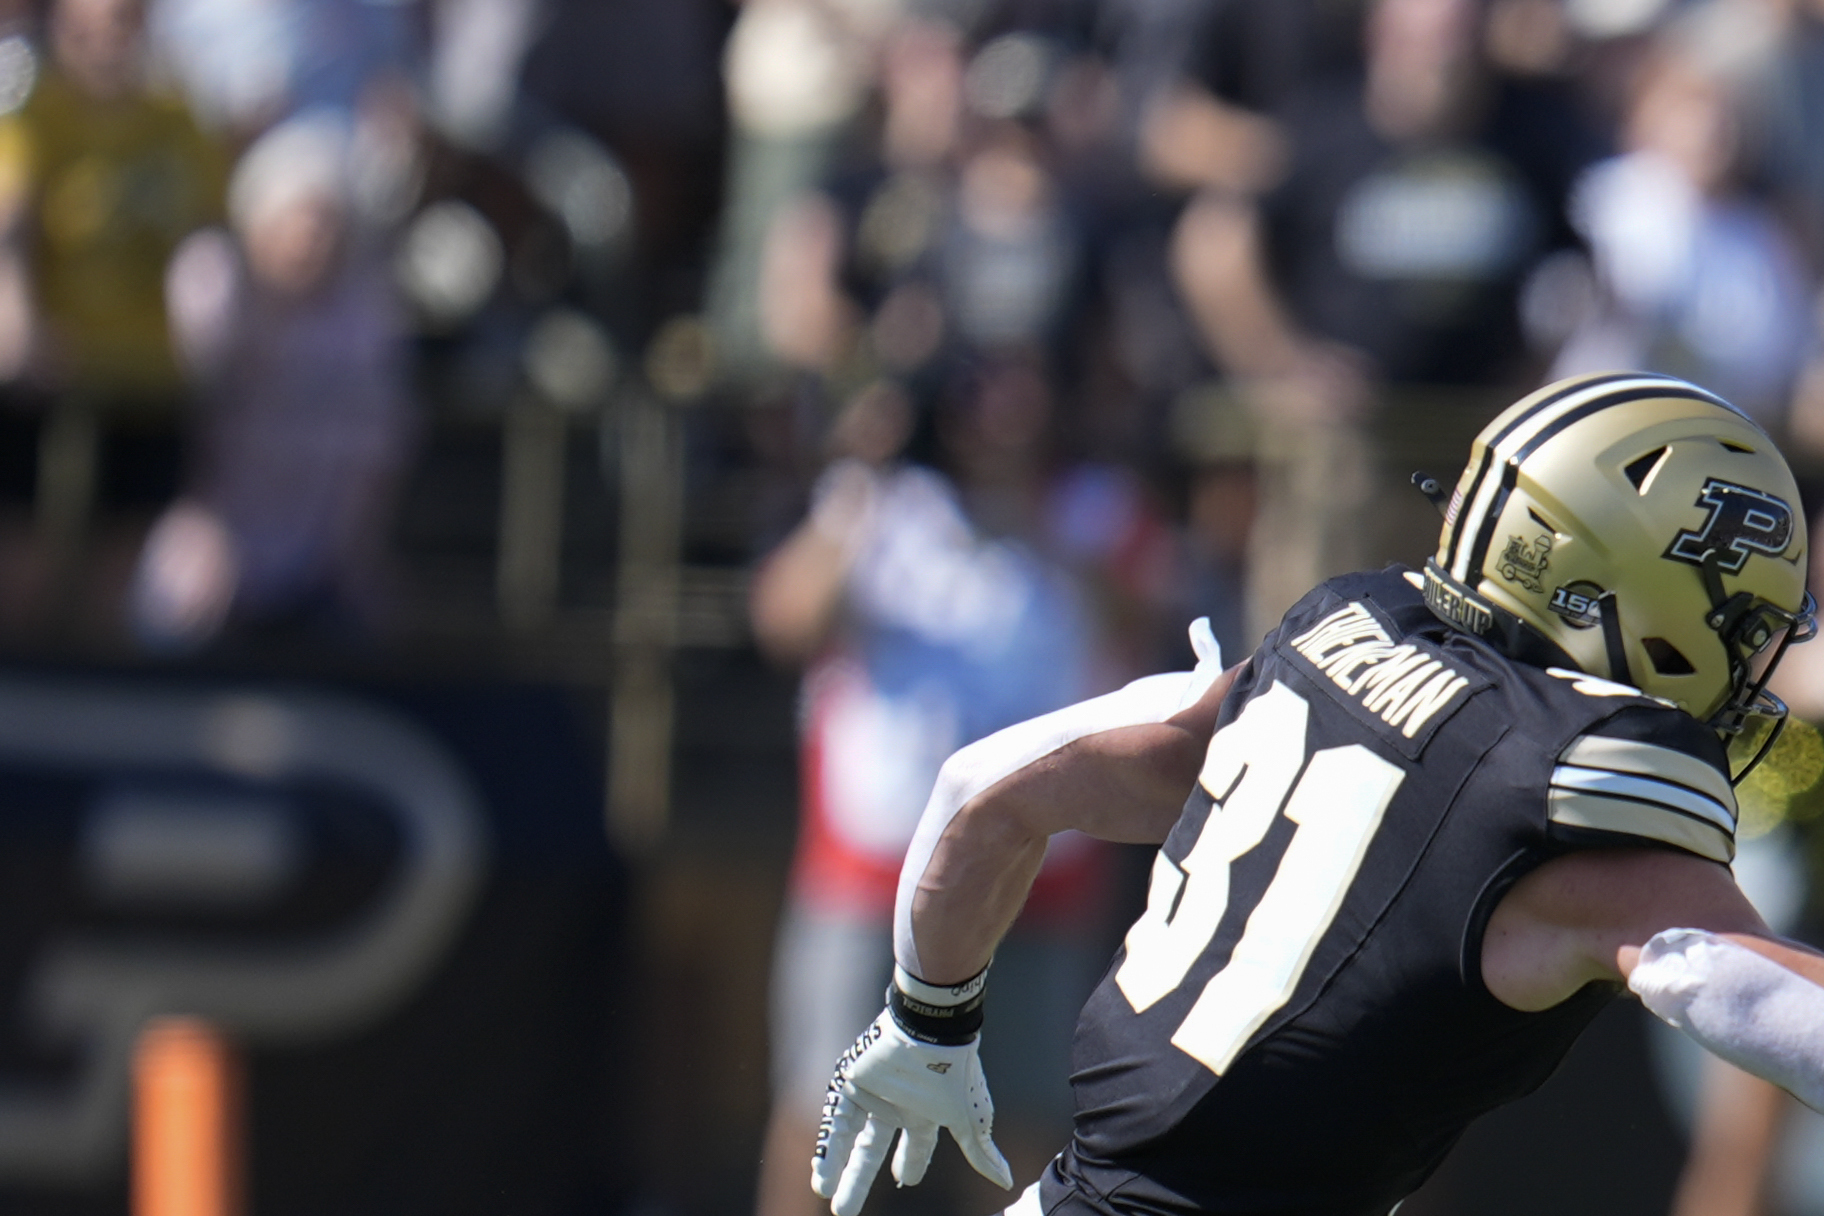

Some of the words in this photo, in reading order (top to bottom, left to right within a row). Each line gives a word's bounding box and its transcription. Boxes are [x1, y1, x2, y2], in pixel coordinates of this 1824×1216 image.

[1660, 476, 1794, 577] P
[1424, 567, 1462, 623] OILER
[1115, 680, 1406, 1076] 31
